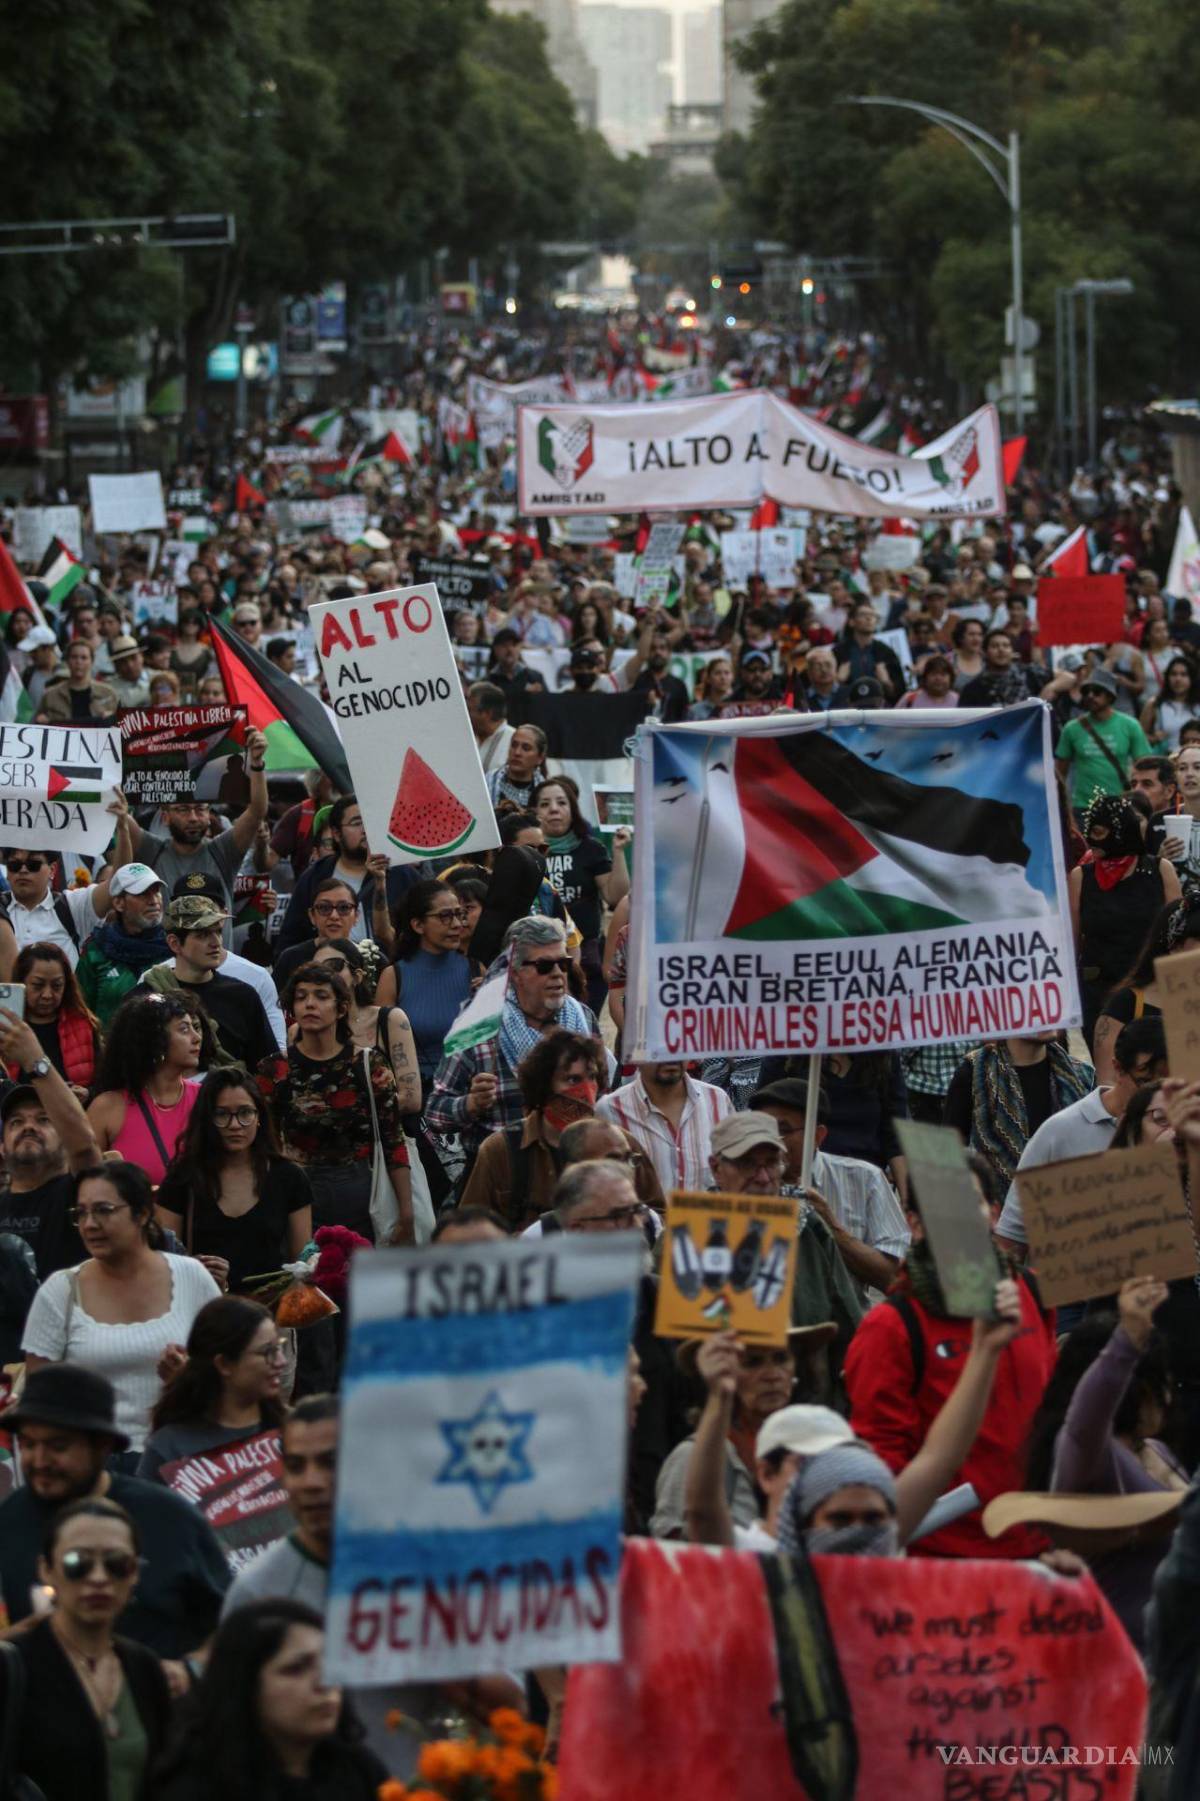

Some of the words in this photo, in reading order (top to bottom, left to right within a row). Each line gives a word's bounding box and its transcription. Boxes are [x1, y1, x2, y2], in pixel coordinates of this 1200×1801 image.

[629, 435, 732, 471] ¡ALTO
[531, 492, 606, 505] AMISTAD
[321, 595, 432, 658] ALTO
[334, 677, 450, 718] GENOCIDIO
[338, 662, 372, 687] AL
[154, 711, 199, 728] PALESTINA
[659, 954, 781, 982] ISRAEL,
[893, 930, 1058, 970] ALEMANIA,
[659, 979, 748, 1007] GRAN
[923, 956, 1063, 992] FRANCIA
[664, 1005, 818, 1054] CRIMINALES
[828, 999, 904, 1047] LESSA
[910, 981, 1062, 1040] HUMANIDAD
[405, 1253, 569, 1320] ISRAEL
[346, 1545, 612, 1653] GENOCIDAS
[924, 1600, 1006, 1638] must
